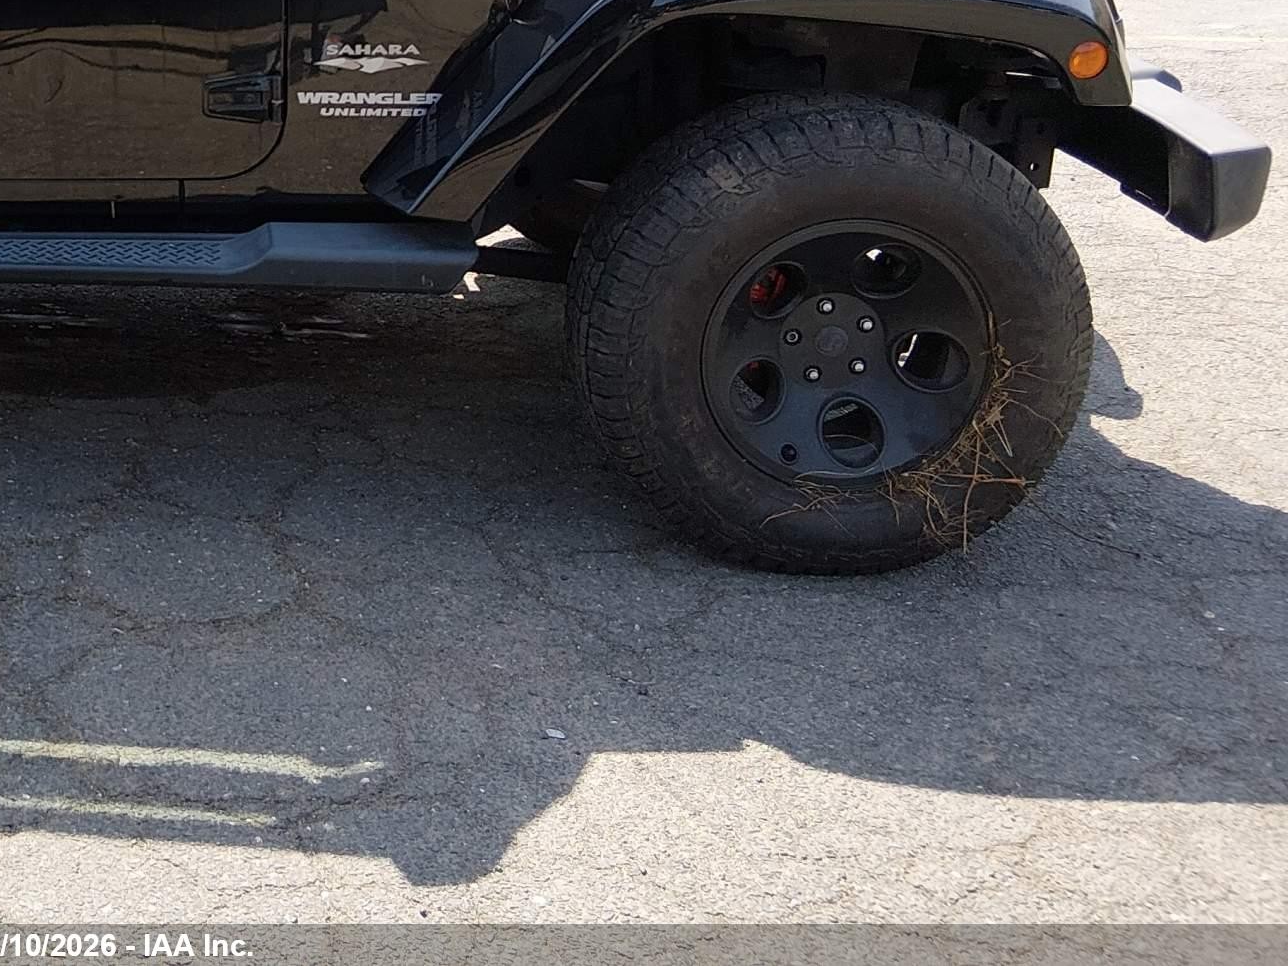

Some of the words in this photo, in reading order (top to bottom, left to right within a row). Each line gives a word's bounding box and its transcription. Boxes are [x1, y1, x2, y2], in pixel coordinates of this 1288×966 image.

[325, 43, 421, 56] SAHARA
[297, 91, 443, 105] WRANGLER
[319, 107, 428, 118] UNLIMITED
